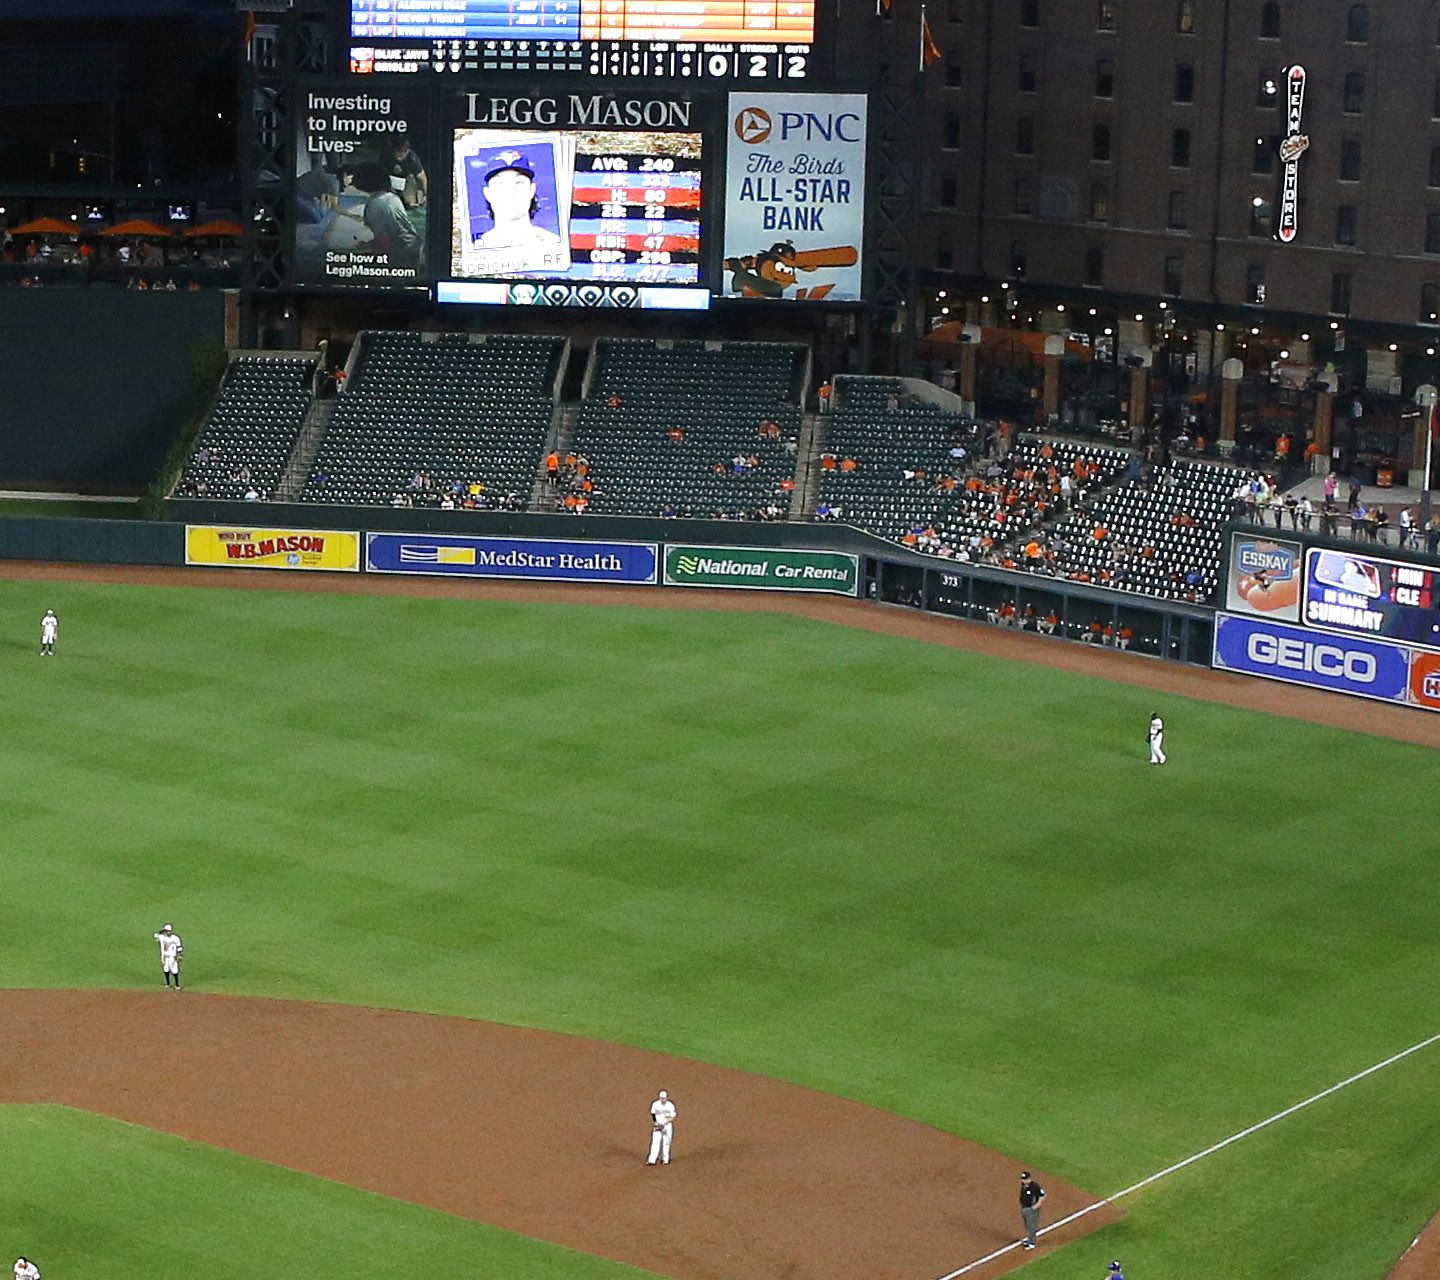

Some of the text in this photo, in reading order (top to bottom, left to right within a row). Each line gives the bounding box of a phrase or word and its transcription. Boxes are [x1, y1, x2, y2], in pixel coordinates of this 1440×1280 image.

[708, 55, 728, 77] 0
[749, 55, 767, 77] 2
[788, 56, 807, 78] 2
[307, 93, 391, 115] Investing
[465, 93, 692, 127] LEGG MASON
[307, 115, 407, 135] to Improve
[778, 112, 860, 142] PNC
[592, 157, 674, 172] AVG: .240
[746, 152, 846, 175] The Birds
[739, 177, 850, 204] ALL-STAR
[1284, 163, 1296, 226] STORE
[644, 206, 665, 219] 22
[763, 206, 825, 232] BANK
[325, 251, 388, 264] See how at
[325, 265, 416, 278] LeggMason.com
[479, 550, 622, 571] MedStar Health
[1242, 550, 1289, 571] ESSKAY
[774, 565, 802, 577] Car
[803, 565, 848, 580] Rental
[942, 575, 958, 587] 373
[1396, 587, 1421, 606] CLE
[1308, 602, 1383, 631] SUMMARY
[1248, 632, 1377, 683] GEICO
